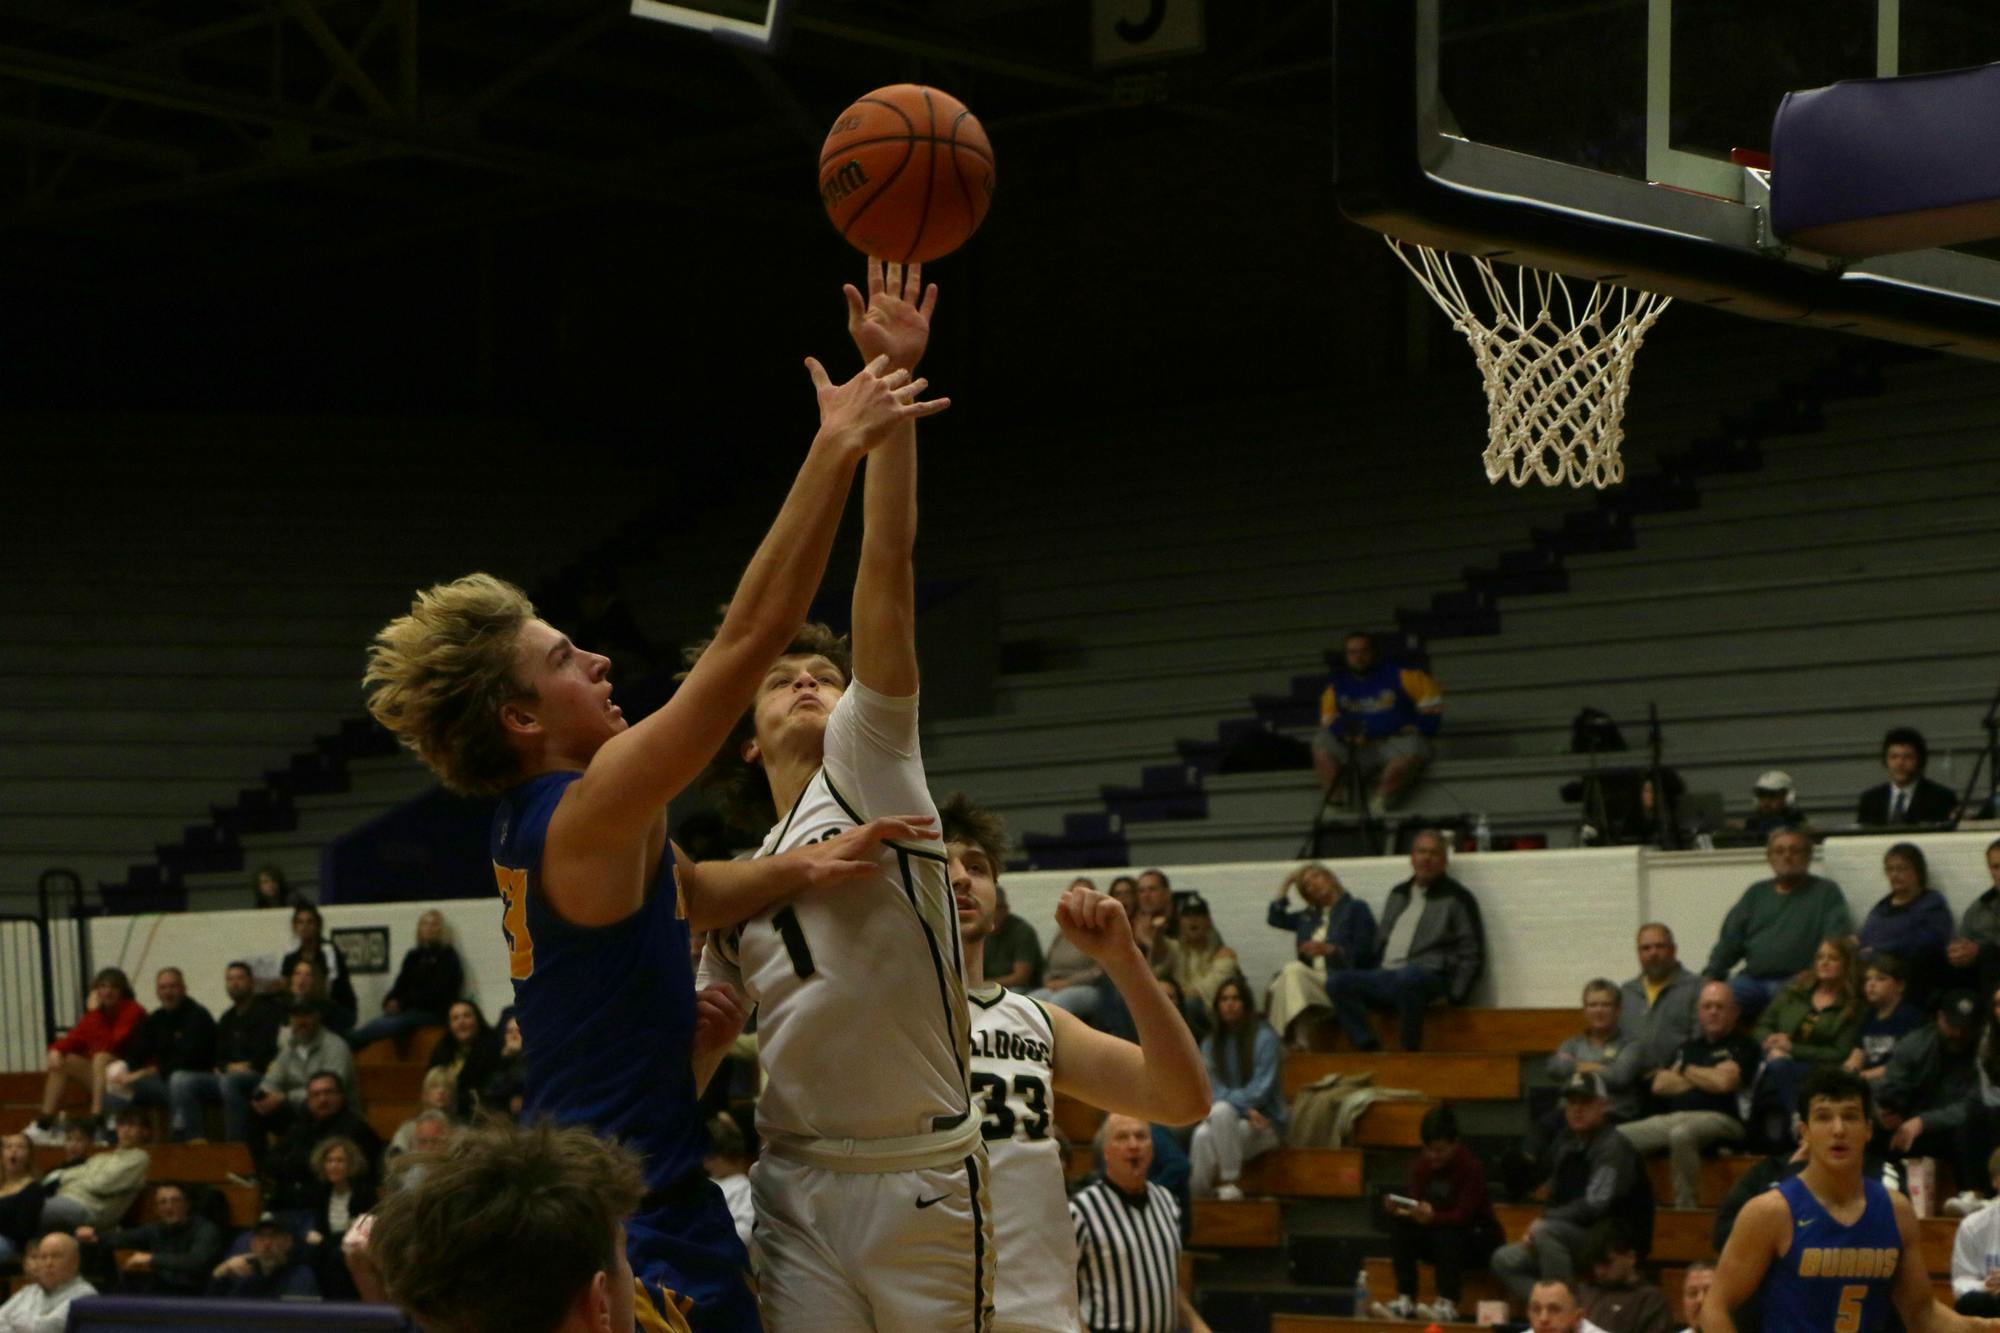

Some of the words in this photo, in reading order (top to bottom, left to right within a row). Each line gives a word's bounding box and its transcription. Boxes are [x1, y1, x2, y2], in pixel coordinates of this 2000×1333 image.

[771, 905, 815, 979] 1
[970, 1029, 1053, 1069] LLDOGS
[970, 1072, 1049, 1140] 33
[1798, 1247, 1899, 1279] BURRIS
[1834, 1284, 1869, 1333] 5
